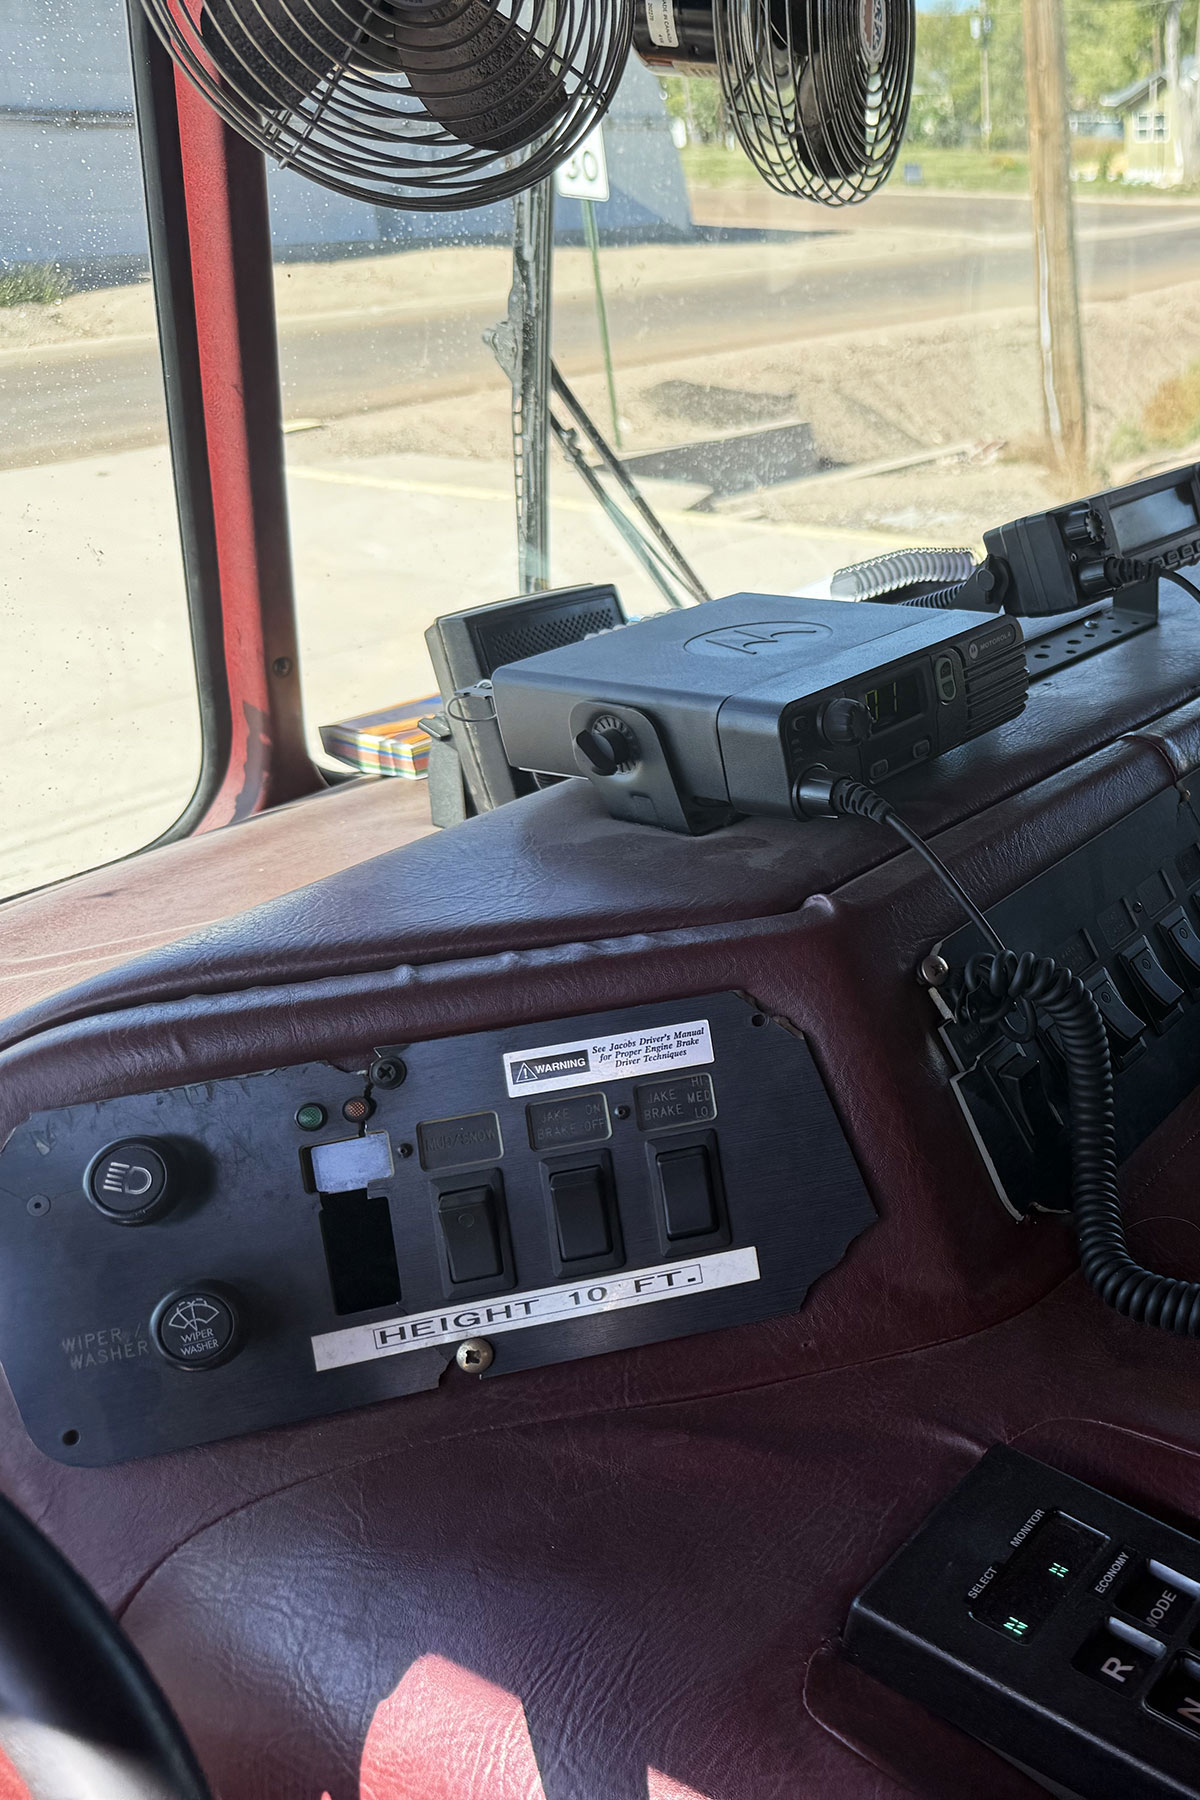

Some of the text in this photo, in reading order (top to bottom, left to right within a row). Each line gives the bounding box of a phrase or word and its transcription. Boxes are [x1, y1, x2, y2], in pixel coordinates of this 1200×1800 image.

[979, 631, 1012, 651] MOTOROLA
[592, 1027, 705, 1055] See Jacobs Driver's Manual
[598, 1037, 700, 1064] for Proper Engine Brake
[535, 1057, 586, 1074] WARNING
[615, 1049, 688, 1068] Driver Techniques
[647, 1088, 711, 1104] JAKE MED
[541, 1104, 602, 1124] JAKE ON
[643, 1104, 708, 1121] BRAKE LO
[537, 1118, 606, 1141] BRAKE OFF
[379, 1271, 697, 1345] HEIGHT 10 FT.
[61, 1327, 122, 1355] WIPER
[179, 1327, 216, 1343] WIPER
[180, 1338, 220, 1356] WASHER
[69, 1340, 150, 1371] WASHER
[1009, 1507, 1046, 1549] MONITOR
[967, 1565, 998, 1600] SELECT
[1094, 1551, 1130, 1595] ECONOMY
[1145, 1589, 1178, 1629] MODE
[1100, 1656, 1136, 1683] R
